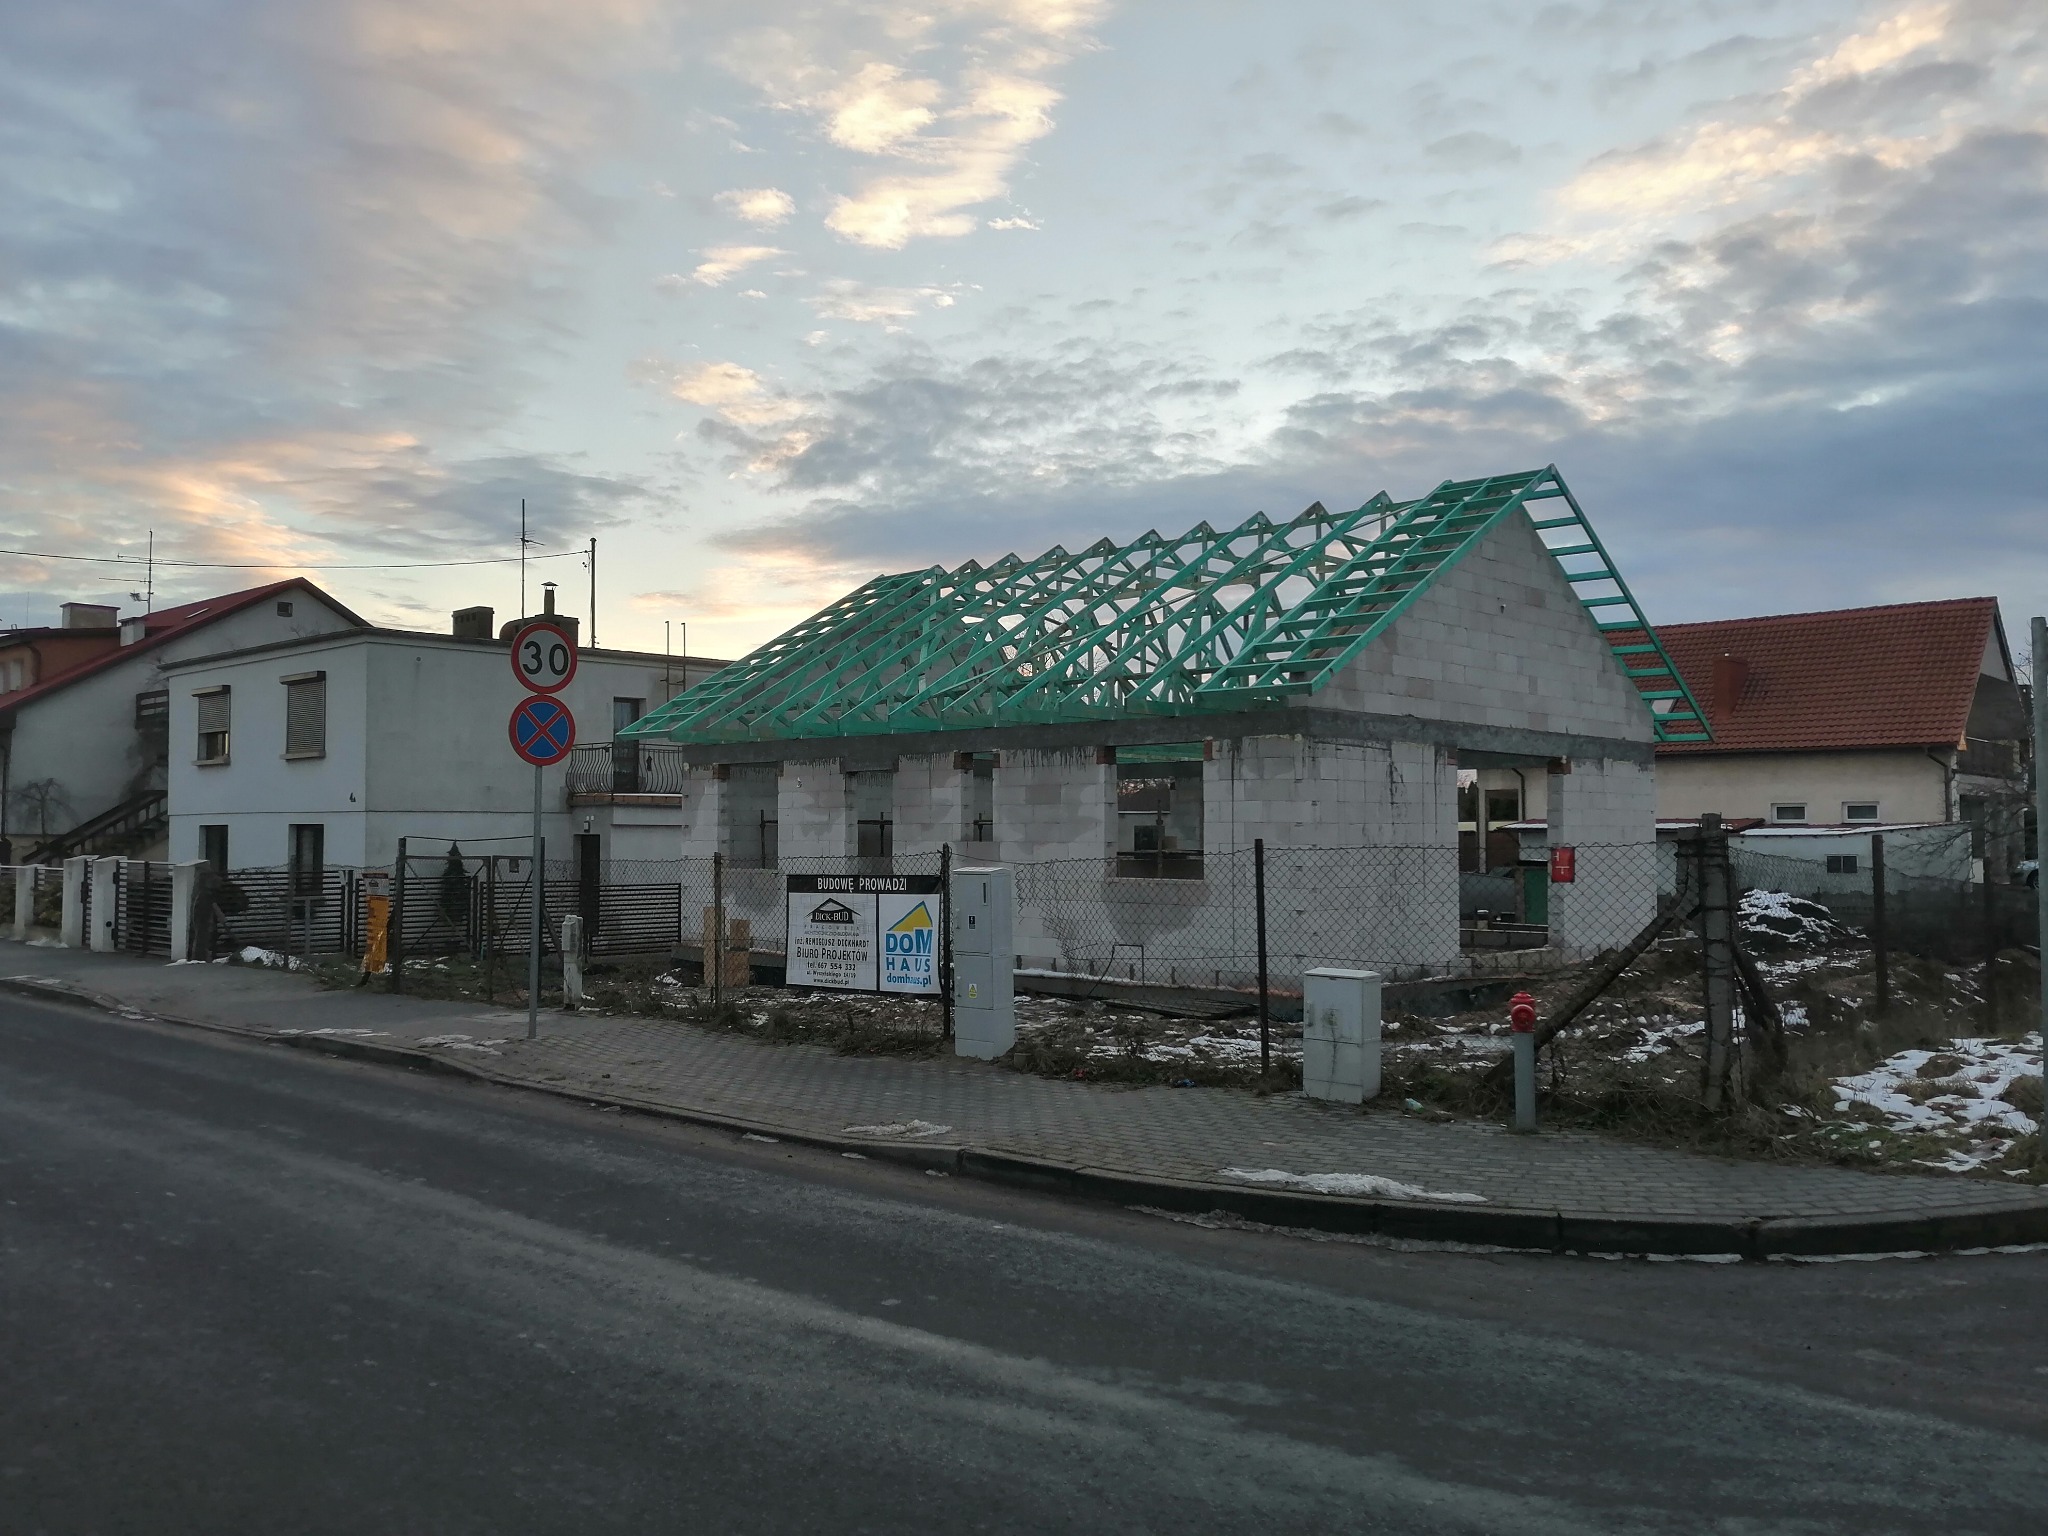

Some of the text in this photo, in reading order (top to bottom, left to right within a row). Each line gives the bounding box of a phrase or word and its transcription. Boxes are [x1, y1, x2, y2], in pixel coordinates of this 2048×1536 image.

[522, 641, 569, 676] 30
[817, 877, 854, 893] BUDOWĘ
[815, 911, 849, 921] DICK-BUD
[837, 939, 870, 948] DICKHARDT
[886, 929, 933, 954] DOM
[796, 946, 868, 961] BIURO PROJEKTÓW
[886, 957, 931, 972] HAUS
[886, 972, 932, 987] domhaus.pl
